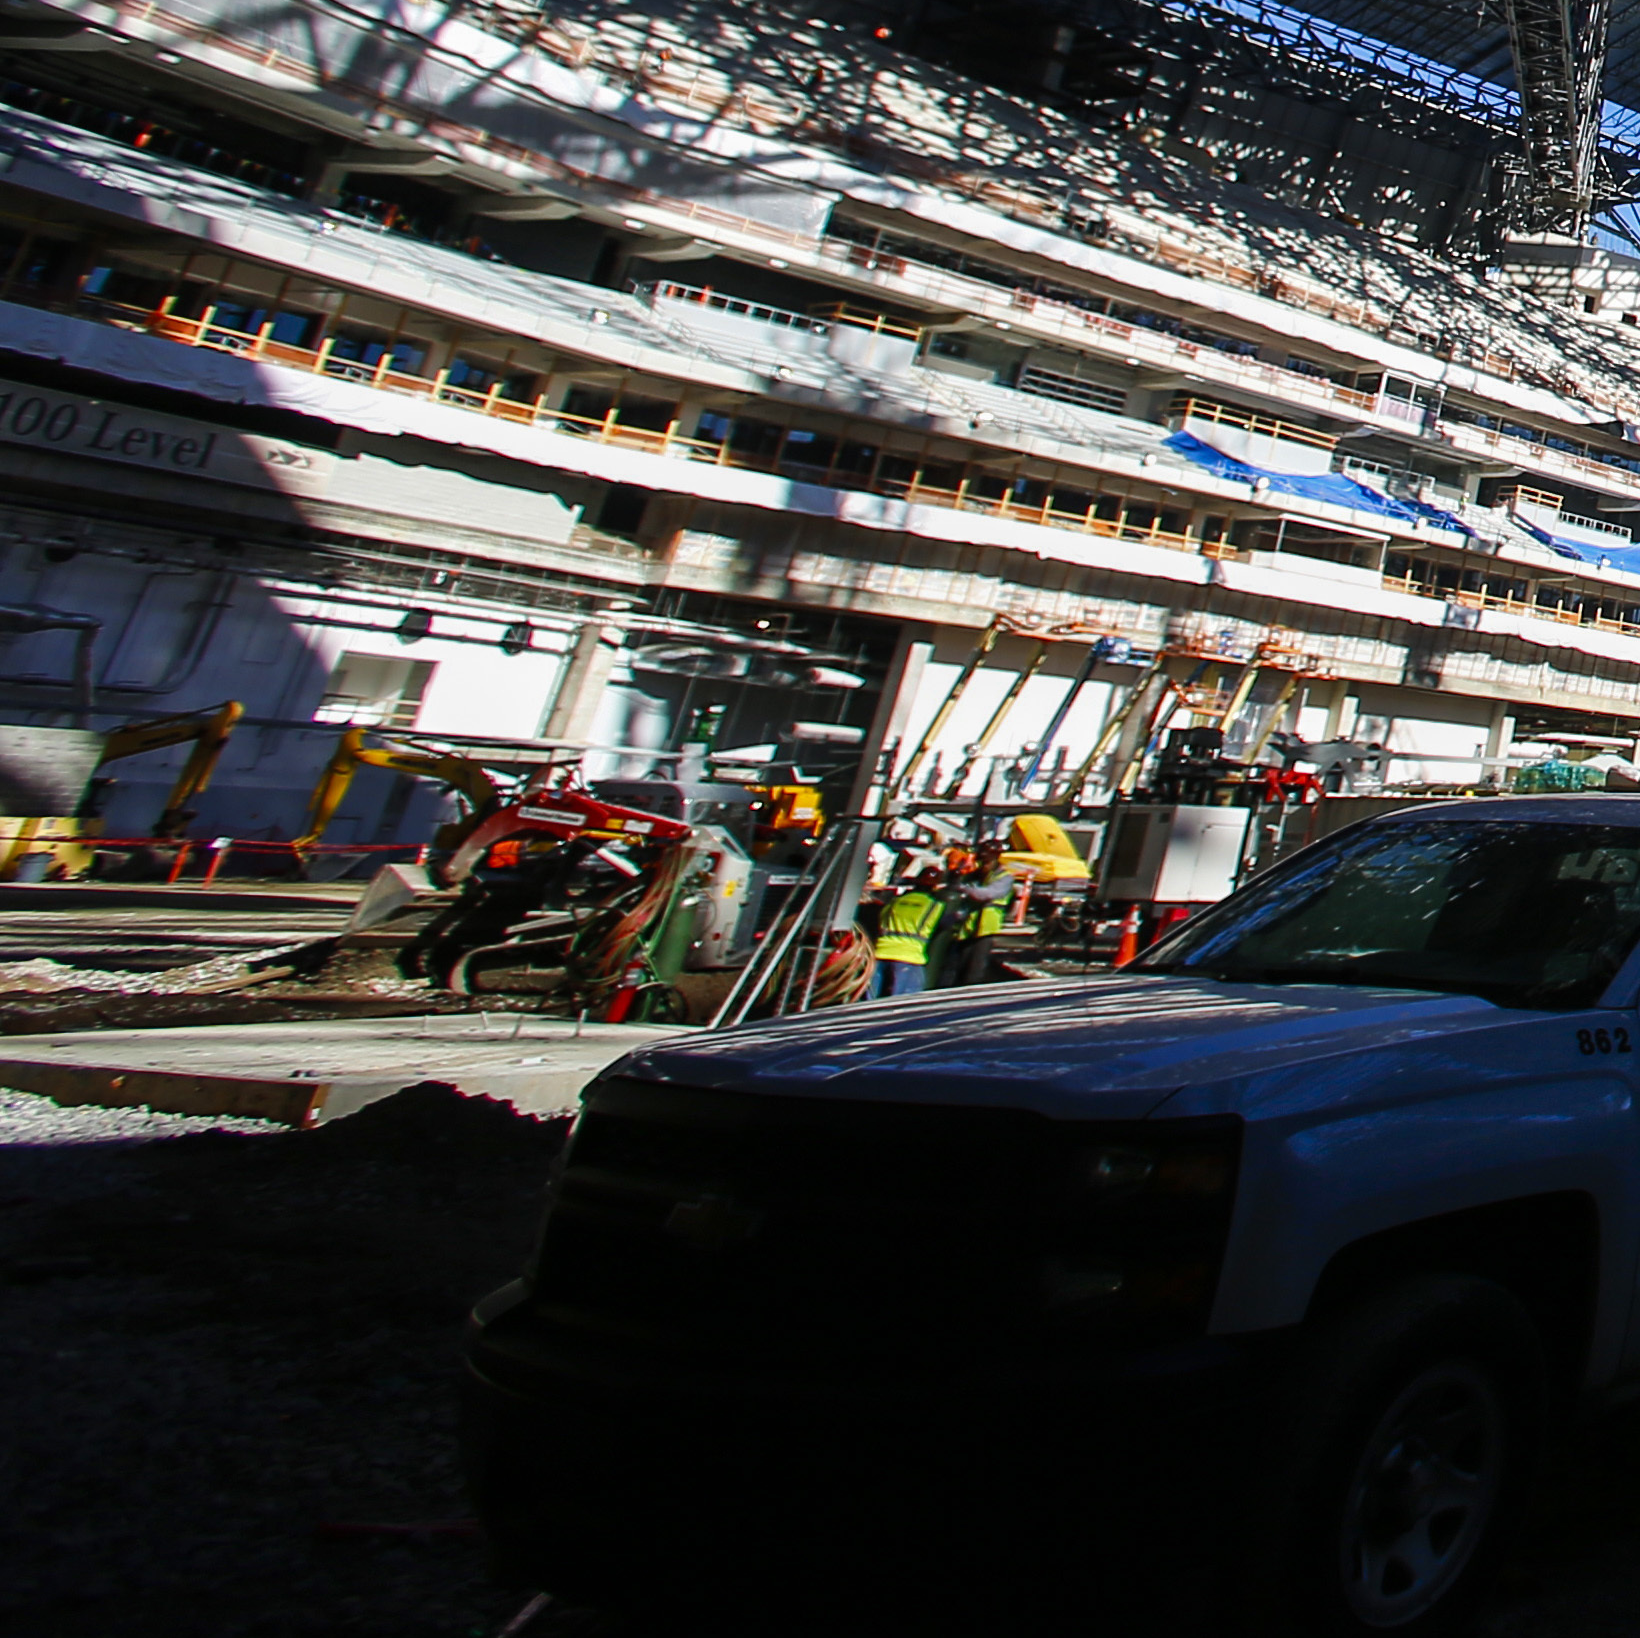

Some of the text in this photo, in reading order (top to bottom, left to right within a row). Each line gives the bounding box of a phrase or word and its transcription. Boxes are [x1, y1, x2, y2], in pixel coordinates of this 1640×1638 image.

[0, 392, 220, 469] 100 Level
[1576, 1027, 1632, 1055] 862
